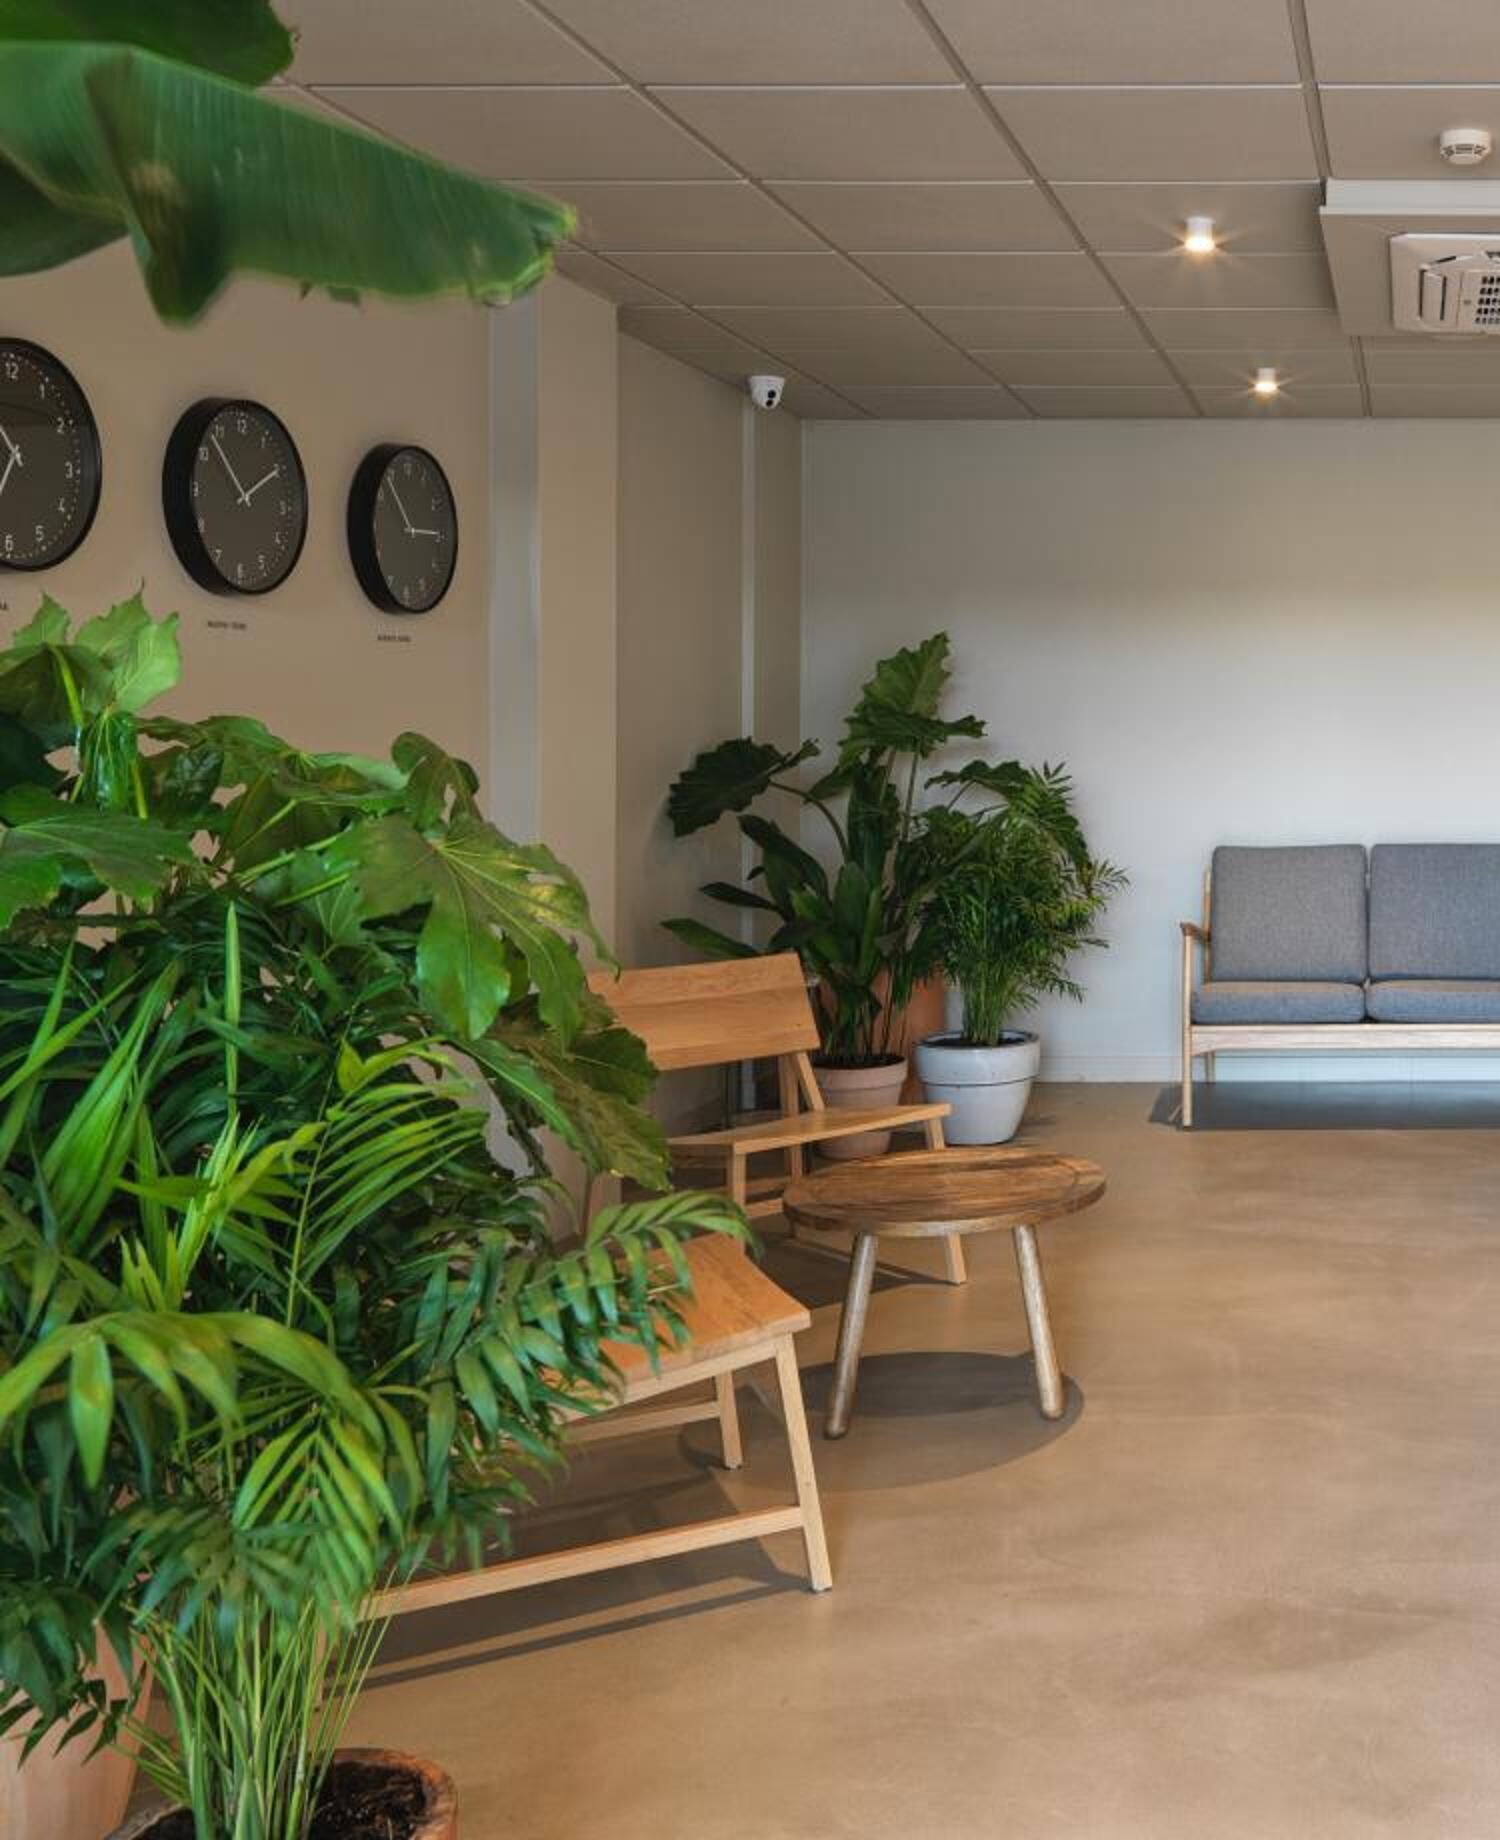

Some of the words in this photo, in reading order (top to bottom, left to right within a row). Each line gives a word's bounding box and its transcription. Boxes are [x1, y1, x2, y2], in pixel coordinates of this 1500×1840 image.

[5, 361, 19, 380] 12
[39, 383, 46, 398] 1
[57, 417, 65, 433] 2
[236, 419, 248, 434] 12
[65, 461, 74, 479] 3
[57, 497, 65, 512] 4
[35, 525, 45, 542] 5
[5, 535, 14, 551] 6
